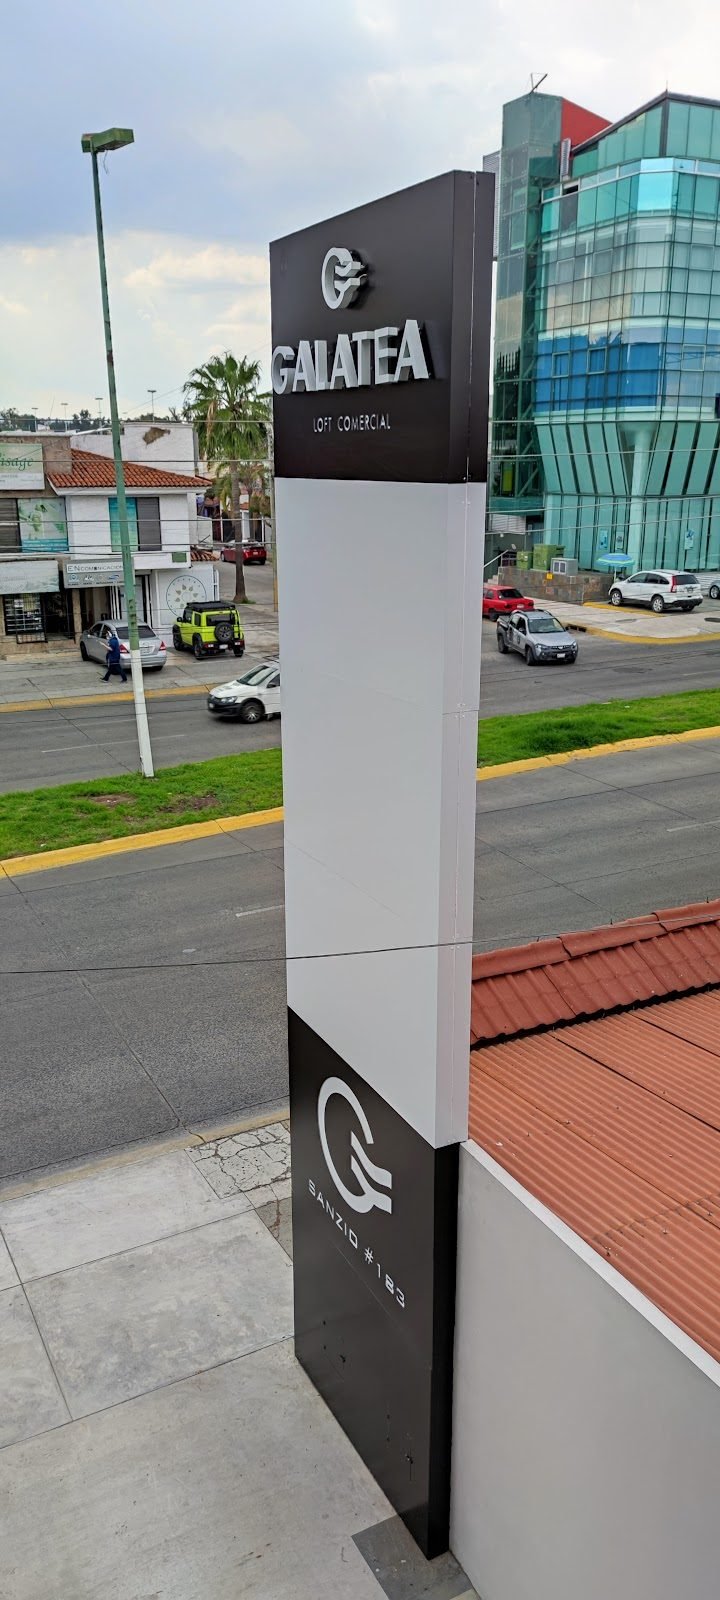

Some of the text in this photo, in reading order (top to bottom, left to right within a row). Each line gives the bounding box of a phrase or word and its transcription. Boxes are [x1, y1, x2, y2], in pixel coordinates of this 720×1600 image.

[271, 319, 430, 395] GALATEA
[313, 413, 391, 432] LOFT COMERCIAL
[0, 452, 33, 471] isage
[308, 1179, 405, 1308] SANZIO #183
